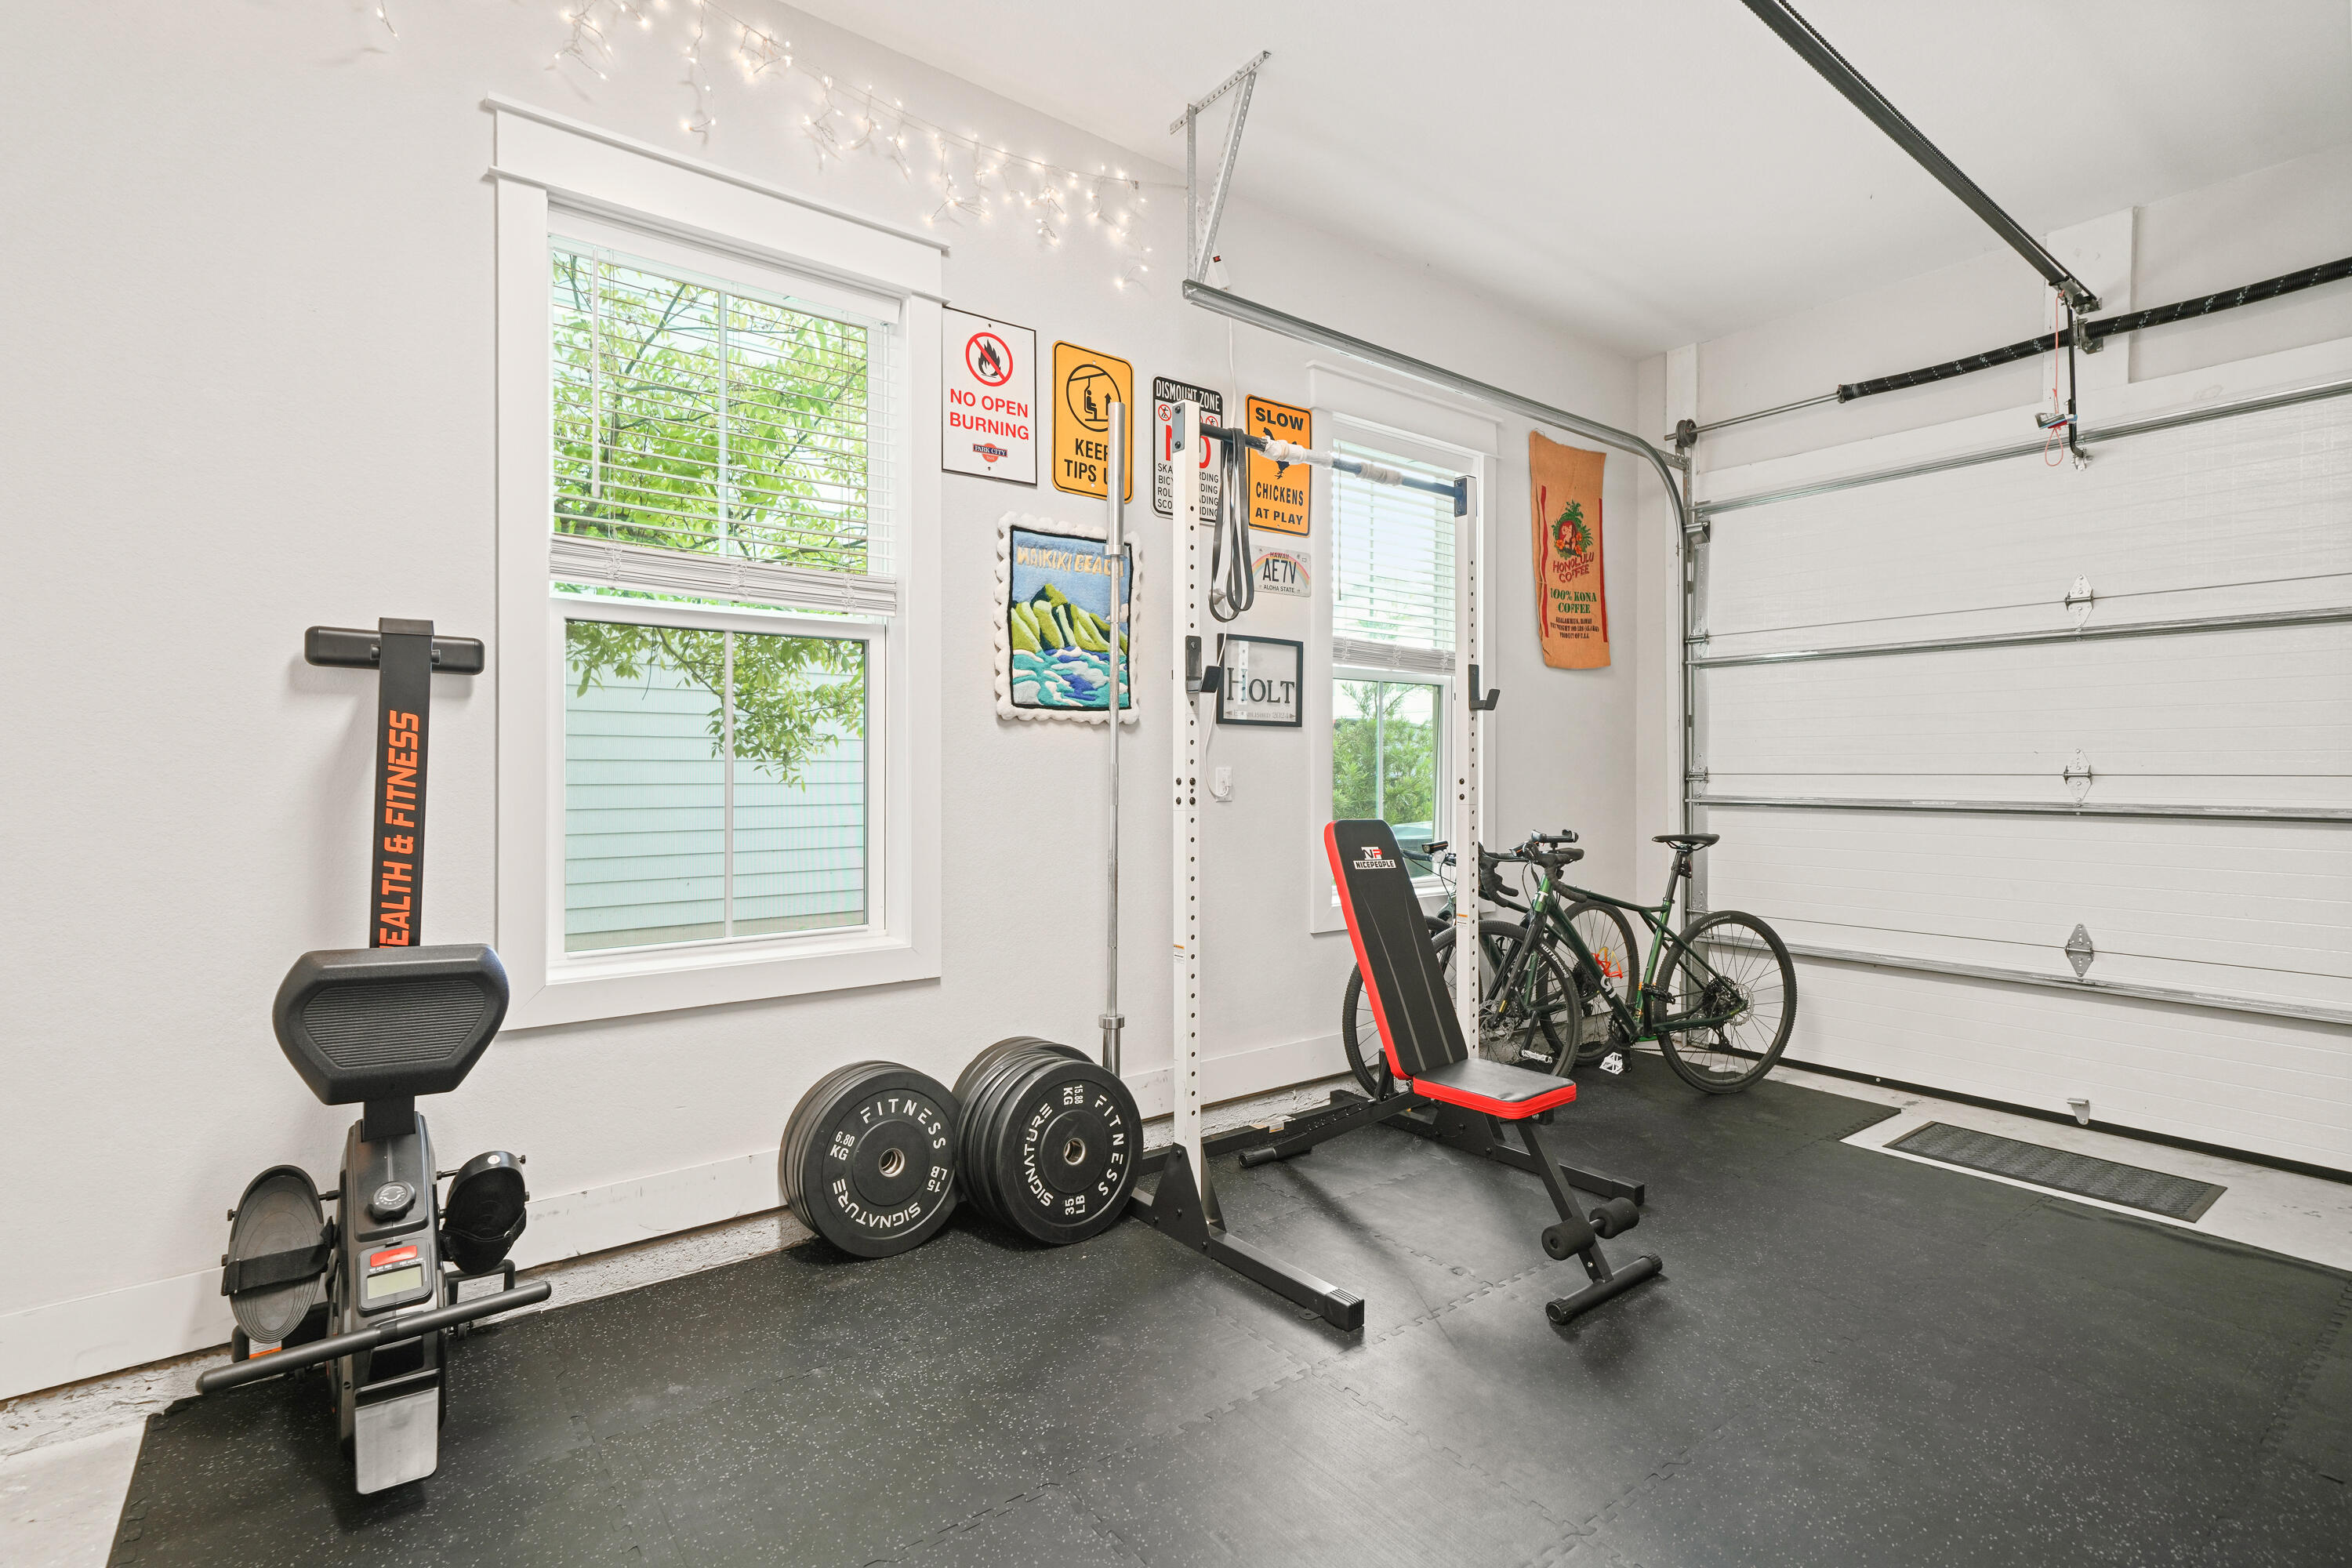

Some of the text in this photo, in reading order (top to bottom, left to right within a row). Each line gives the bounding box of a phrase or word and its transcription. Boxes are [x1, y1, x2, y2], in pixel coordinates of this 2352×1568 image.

[950, 389, 1028, 418] NO OPEN
[1156, 379, 1220, 412] DISMOUNT ZONE
[950, 412, 1029, 440] BURNING
[1255, 407, 1304, 430] SLOW
[1064, 459, 1097, 482] TIPS
[1256, 481, 1304, 506] CHICKENS
[1255, 507, 1303, 525] AT PLAY
[1017, 546, 1124, 577] WAIKIKI BEAC
[1263, 557, 1296, 584] AE7V
[1552, 552, 1595, 573] HONOLULU
[1559, 564, 1591, 583] COFFEE
[1550, 588, 1597, 602] 100% KONA
[1558, 602, 1591, 614] COFFEE
[1227, 667, 1294, 703] HOLT
[385, 710, 419, 828] FITNESS
[383, 834, 414, 855] &
[1064, 1087, 1073, 1105] KG
[1074, 1085, 1083, 1105] 15.88
[860, 1098, 946, 1149] FITNESS
[835, 1131, 855, 1147] 6.80
[1094, 1094, 1124, 1196] FITNESS
[829, 1145, 848, 1161] KG
[1024, 1102, 1053, 1207] SIGNATURE
[931, 1166, 947, 1181] LB
[927, 1180, 941, 1193] 15
[833, 1178, 921, 1229] SIGNATURE
[1065, 1199, 1074, 1215] 35
[1076, 1195, 1086, 1214] LB
